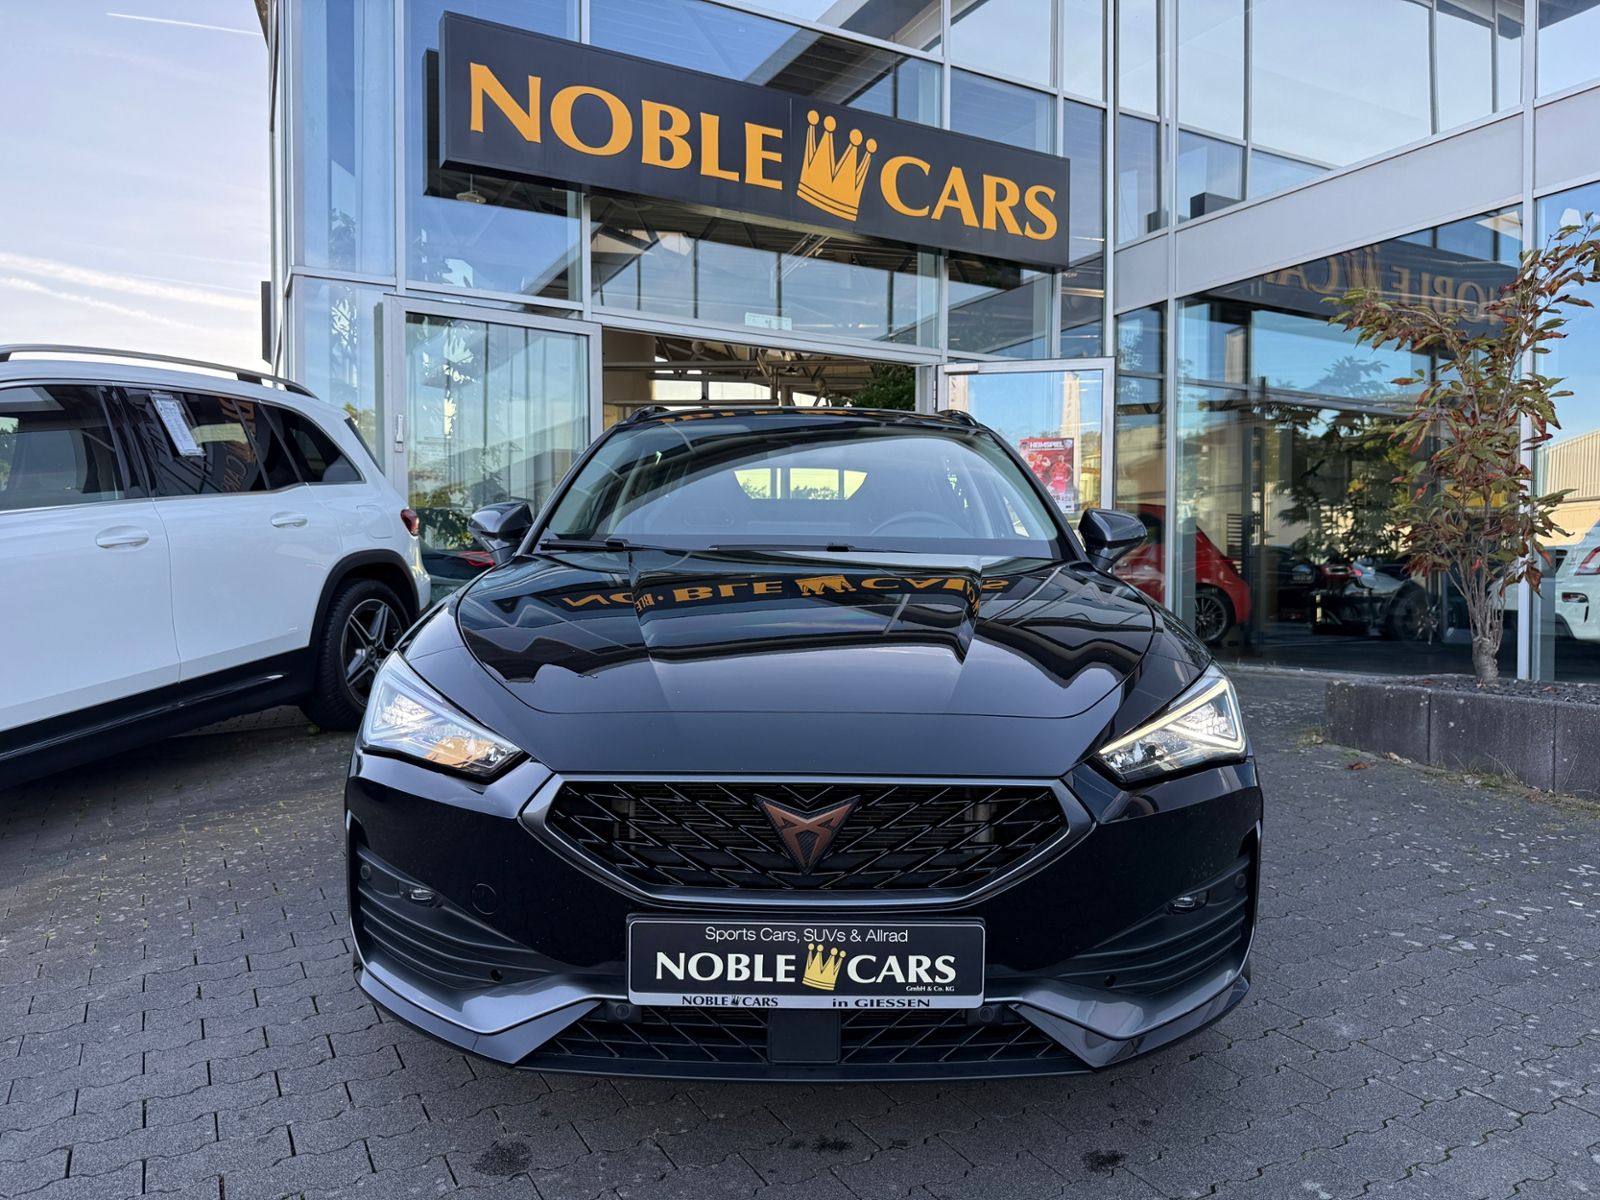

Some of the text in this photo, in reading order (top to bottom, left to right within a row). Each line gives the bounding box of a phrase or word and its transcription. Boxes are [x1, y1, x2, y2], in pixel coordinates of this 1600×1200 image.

[470, 63, 1057, 241] NOBLE CARS
[704, 926, 909, 944] Sports Cars, SUVs & Allrad
[656, 951, 957, 983] NOBLE CARS
[681, 995, 779, 1007] NOBLE CARS
[832, 996, 931, 1008] in GIESSEN
